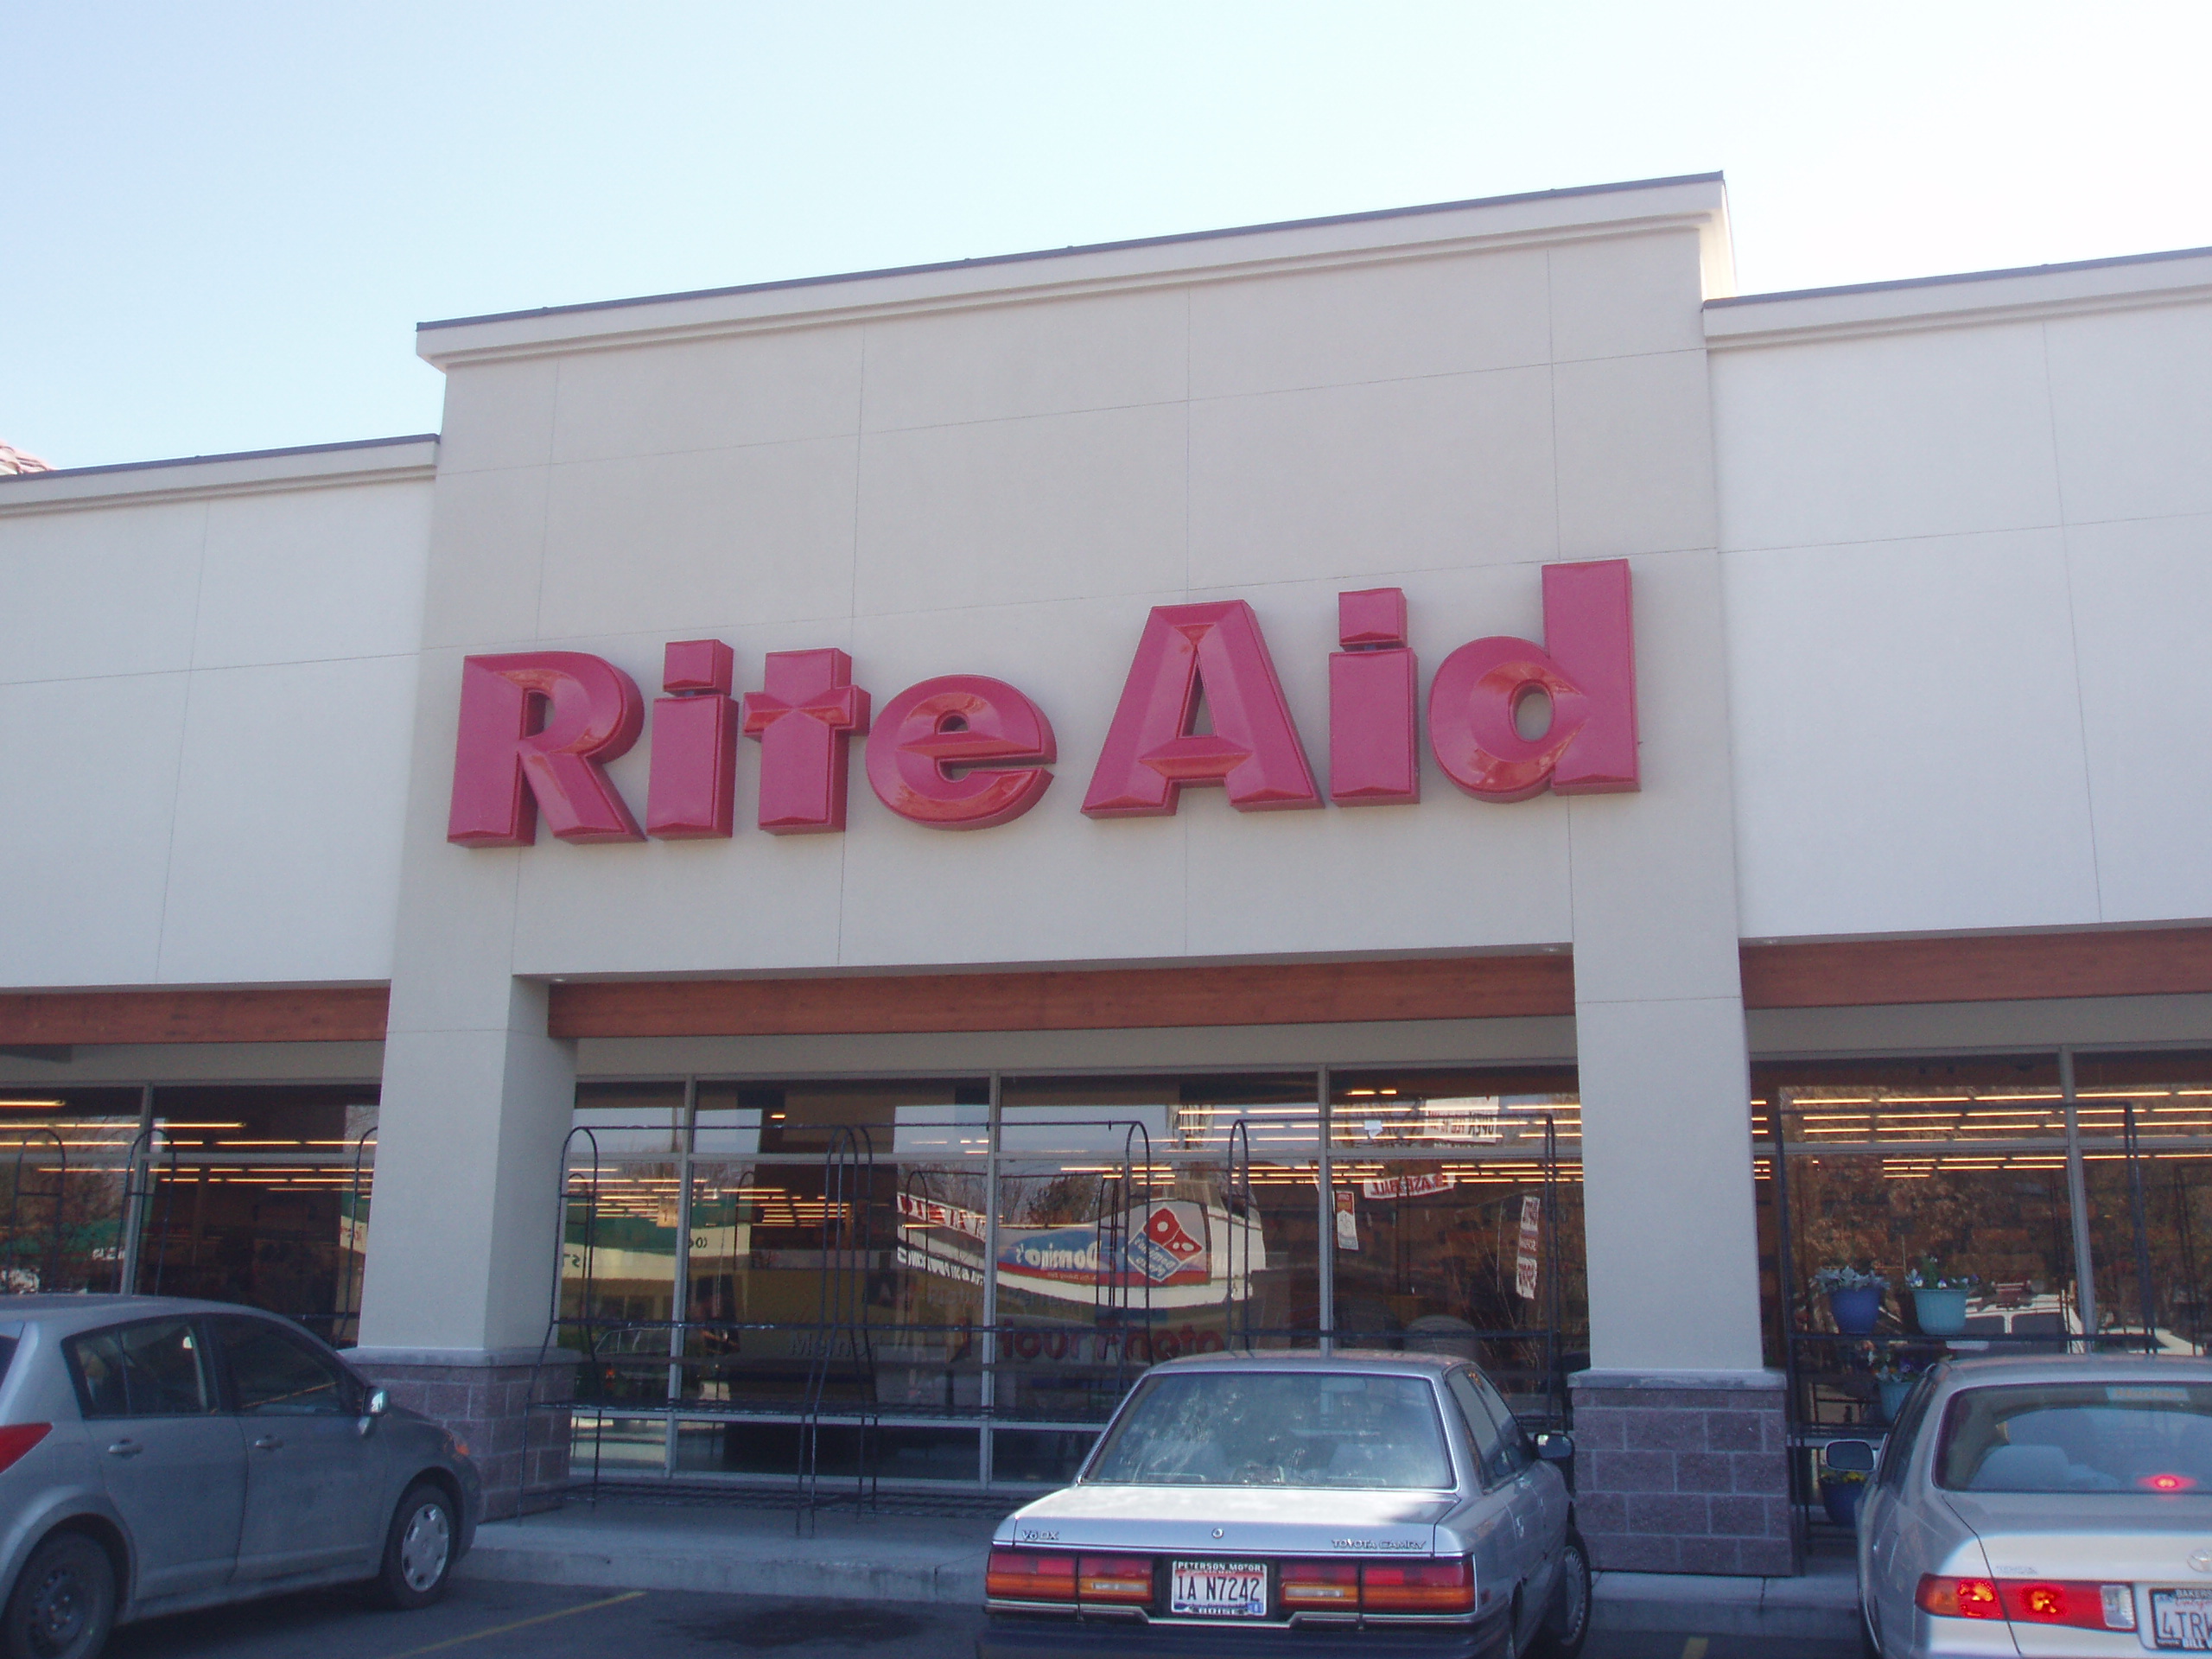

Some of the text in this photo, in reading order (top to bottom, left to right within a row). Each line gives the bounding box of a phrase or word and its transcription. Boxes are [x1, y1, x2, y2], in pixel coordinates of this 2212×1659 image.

[448, 560, 1642, 848] Rite Aid
[1332, 1538, 1427, 1550] TOYOTA CAMRY
[1178, 1561, 1262, 1572] PETERSON MOTOR
[1178, 1575, 1261, 1602] 1A N7242
